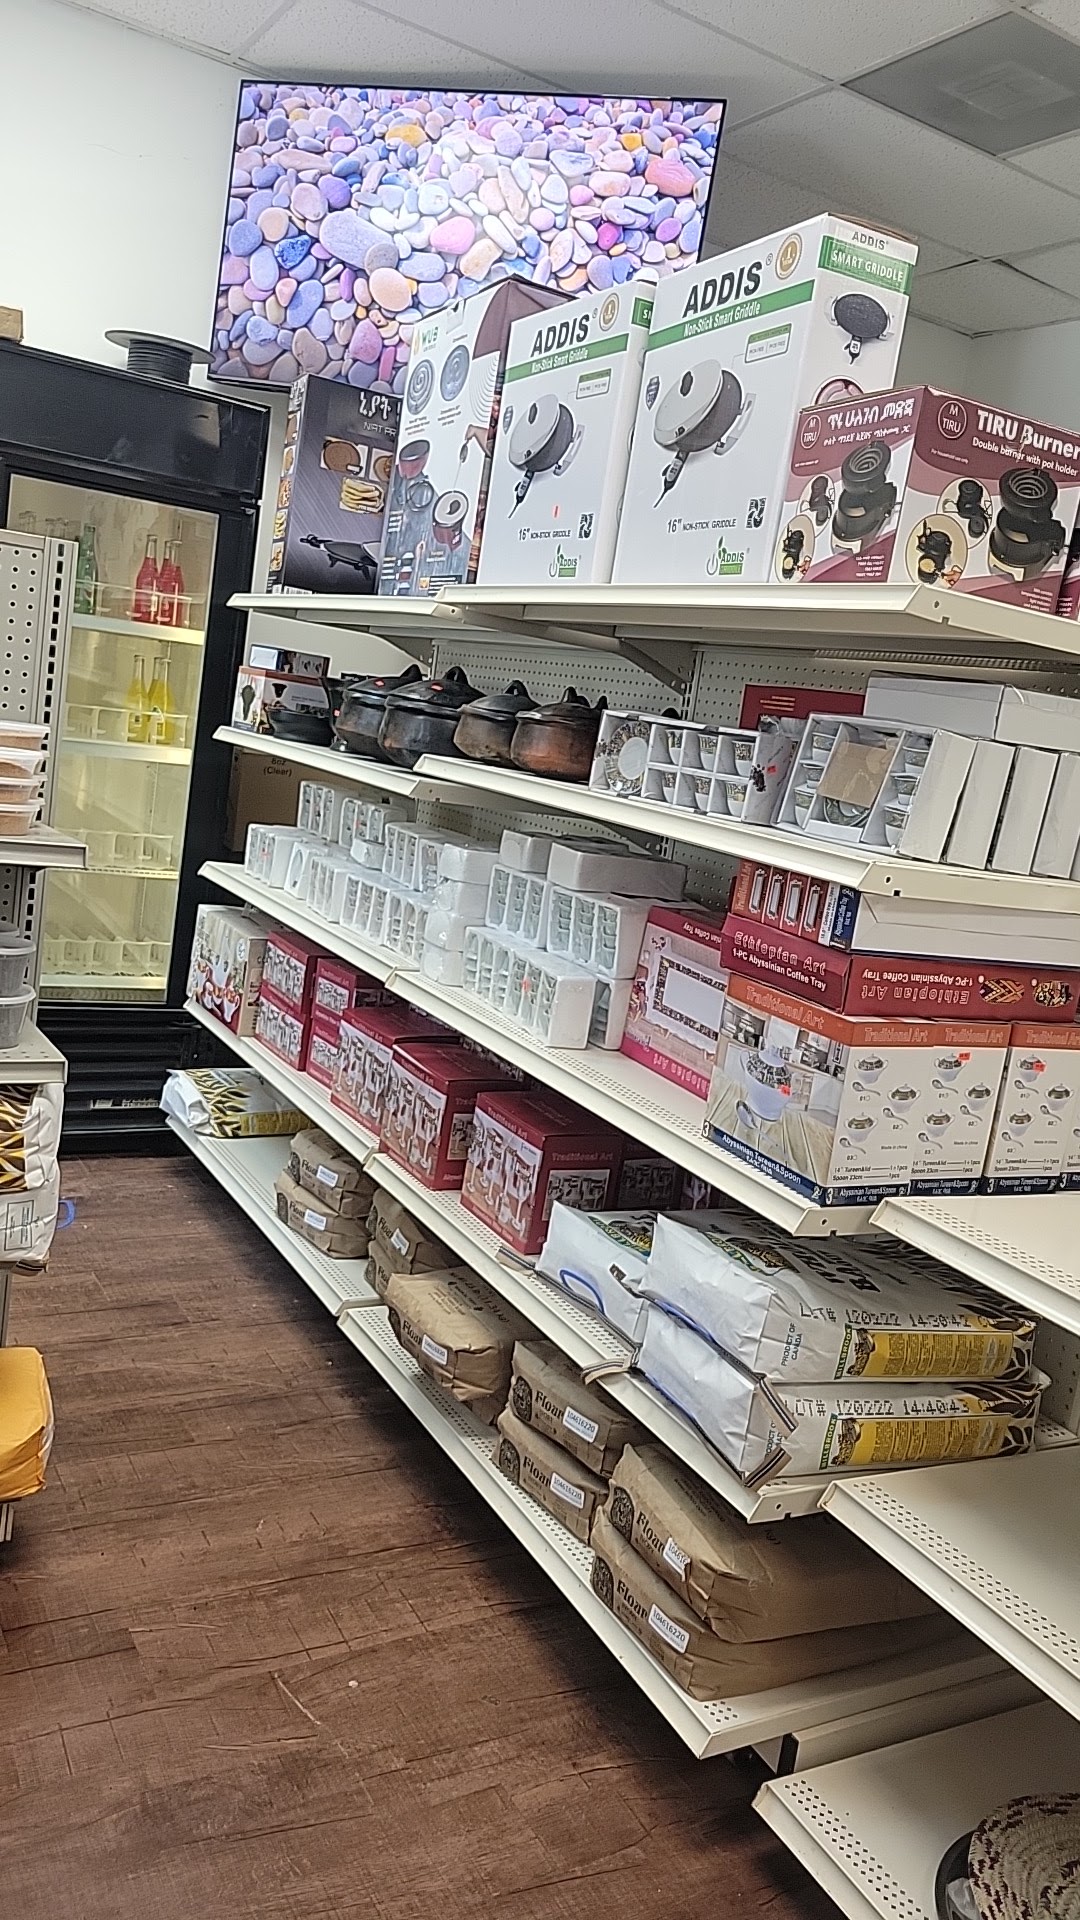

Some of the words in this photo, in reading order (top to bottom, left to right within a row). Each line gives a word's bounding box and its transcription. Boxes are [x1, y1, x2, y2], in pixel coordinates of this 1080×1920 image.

[852, 231, 886, 250] ADDIS
[831, 249, 864, 269] SMART
[865, 261, 903, 282] GRIDDLE
[682, 261, 762, 318] ADDIS
[684, 320, 713, 337] Non-Stick
[714, 310, 733, 328] Smart
[734, 301, 761, 321] Griddle
[530, 314, 590, 357] ADDIS
[553, 354, 568, 369] Smart
[569, 347, 589, 364] Griddle
[949, 403, 958, 416] M
[808, 418, 816, 428] M
[942, 417, 961, 433] TIRU
[803, 431, 817, 443] TIRU
[977, 408, 1018, 440] TIRU
[1019, 424, 1080, 460] Burner
[972, 436, 999, 453] Double
[1000, 445, 1025, 461] burner
[1026, 454, 1041, 466] with
[1042, 459, 1055, 471] pot
[1055, 462, 1079, 477] holder
[552, 529, 571, 538] GRIDDLE
[683, 520, 709, 531] NON-STICK
[711, 519, 736, 528] GRIDDLE
[721, 552, 745, 563] ADDIS
[264, 766, 292, 777] (Clear)
[735, 931, 798, 965] Ethiopian
[803, 956, 827, 976] Art
[733, 948, 748, 960] 1-PC
[749, 953, 785, 975] Abyssinian
[786, 967, 809, 984] Coffee
[810, 976, 827, 992] Tray
[862, 968, 881, 981] Tray
[883, 971, 909, 982] Coffee
[910, 973, 954, 985] Abyssinian
[955, 977, 973, 987] 1-PC
[861, 985, 888, 999] Art
[894, 987, 970, 1005] Ethiopian
[745, 985, 801, 1021] Traditional
[802, 1010, 825, 1030] Art
[864, 1027, 912, 1042] Traditional
[912, 1027, 928, 1042] Art
[945, 1027, 989, 1042] Traditional
[988, 1029, 1004, 1043] Art
[1026, 1029, 1069, 1045] Traditional
[1069, 1032, 1080, 1046] Ar
[652, 1052, 670, 1071] Art
[487, 1107, 517, 1134] Traditional
[722, 1134, 754, 1156] Abyssinian
[788, 1322, 796, 1334] OF
[835, 1327, 852, 1379] MILLBROOK
[535, 1390, 564, 1421] Flour
[837, 1400, 894, 1416] 120222
[567, 1410, 596, 1433] 104616220
[820, 1417, 837, 1468] MILLBROOK
[636, 1511, 664, 1555] Flour
[616, 1580, 648, 1619] Flour
[652, 1608, 685, 1643] 104616220
